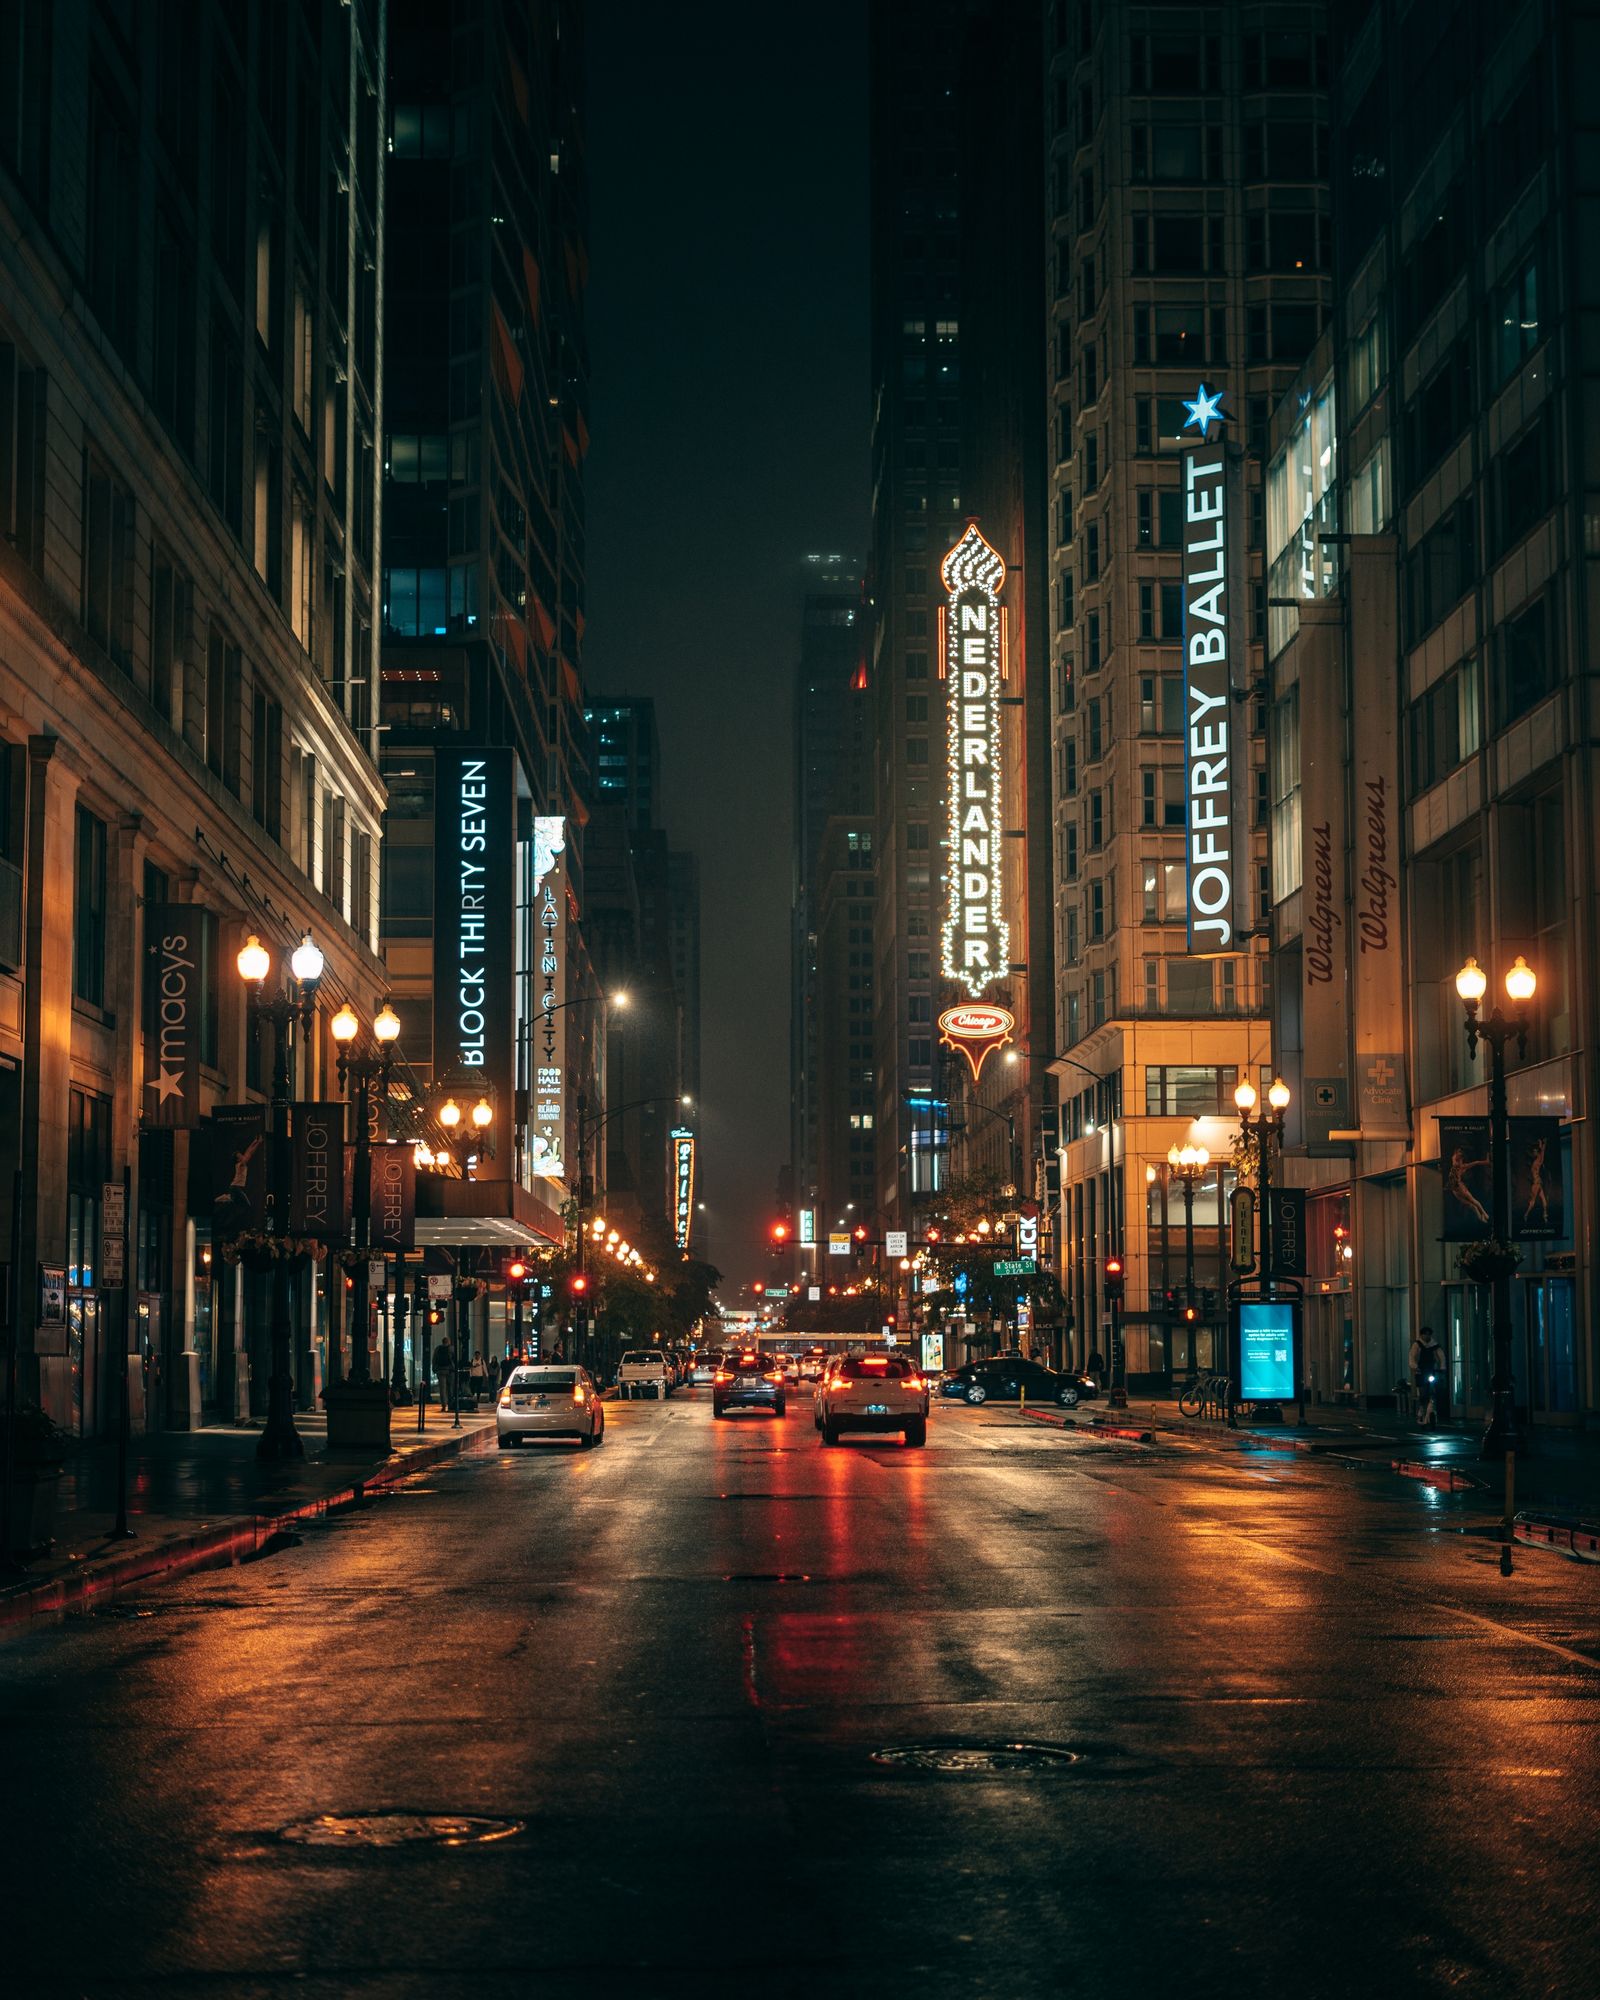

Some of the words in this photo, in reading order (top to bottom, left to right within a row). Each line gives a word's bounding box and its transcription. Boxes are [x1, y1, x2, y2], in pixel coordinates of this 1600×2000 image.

[1186, 457, 1226, 666] BALLET
[462, 761, 487, 853] SEVEN
[961, 604, 990, 969] NEDERLANDER
[1188, 687, 1232, 945] JOFFREY
[461, 864, 485, 959] THIRTY
[1308, 822, 1342, 986] Walgreens
[1361, 777, 1398, 954] Walgreens
[460, 967, 485, 1066] BLOCK
[541, 887, 558, 1063] LATINICITY
[958, 1014, 996, 1029] Chicago
[368, 1080, 385, 1142] acys
[537, 1068, 561, 1077] FOOD
[537, 1076, 561, 1085] HALL
[1371, 1096, 1393, 1104] Clinic
[304, 1115, 328, 1225] JOFFREY
[382, 1152, 404, 1244] JOFFREY
[1020, 1216, 1037, 1261] LICK
[1280, 1196, 1296, 1268] JOFFREY
